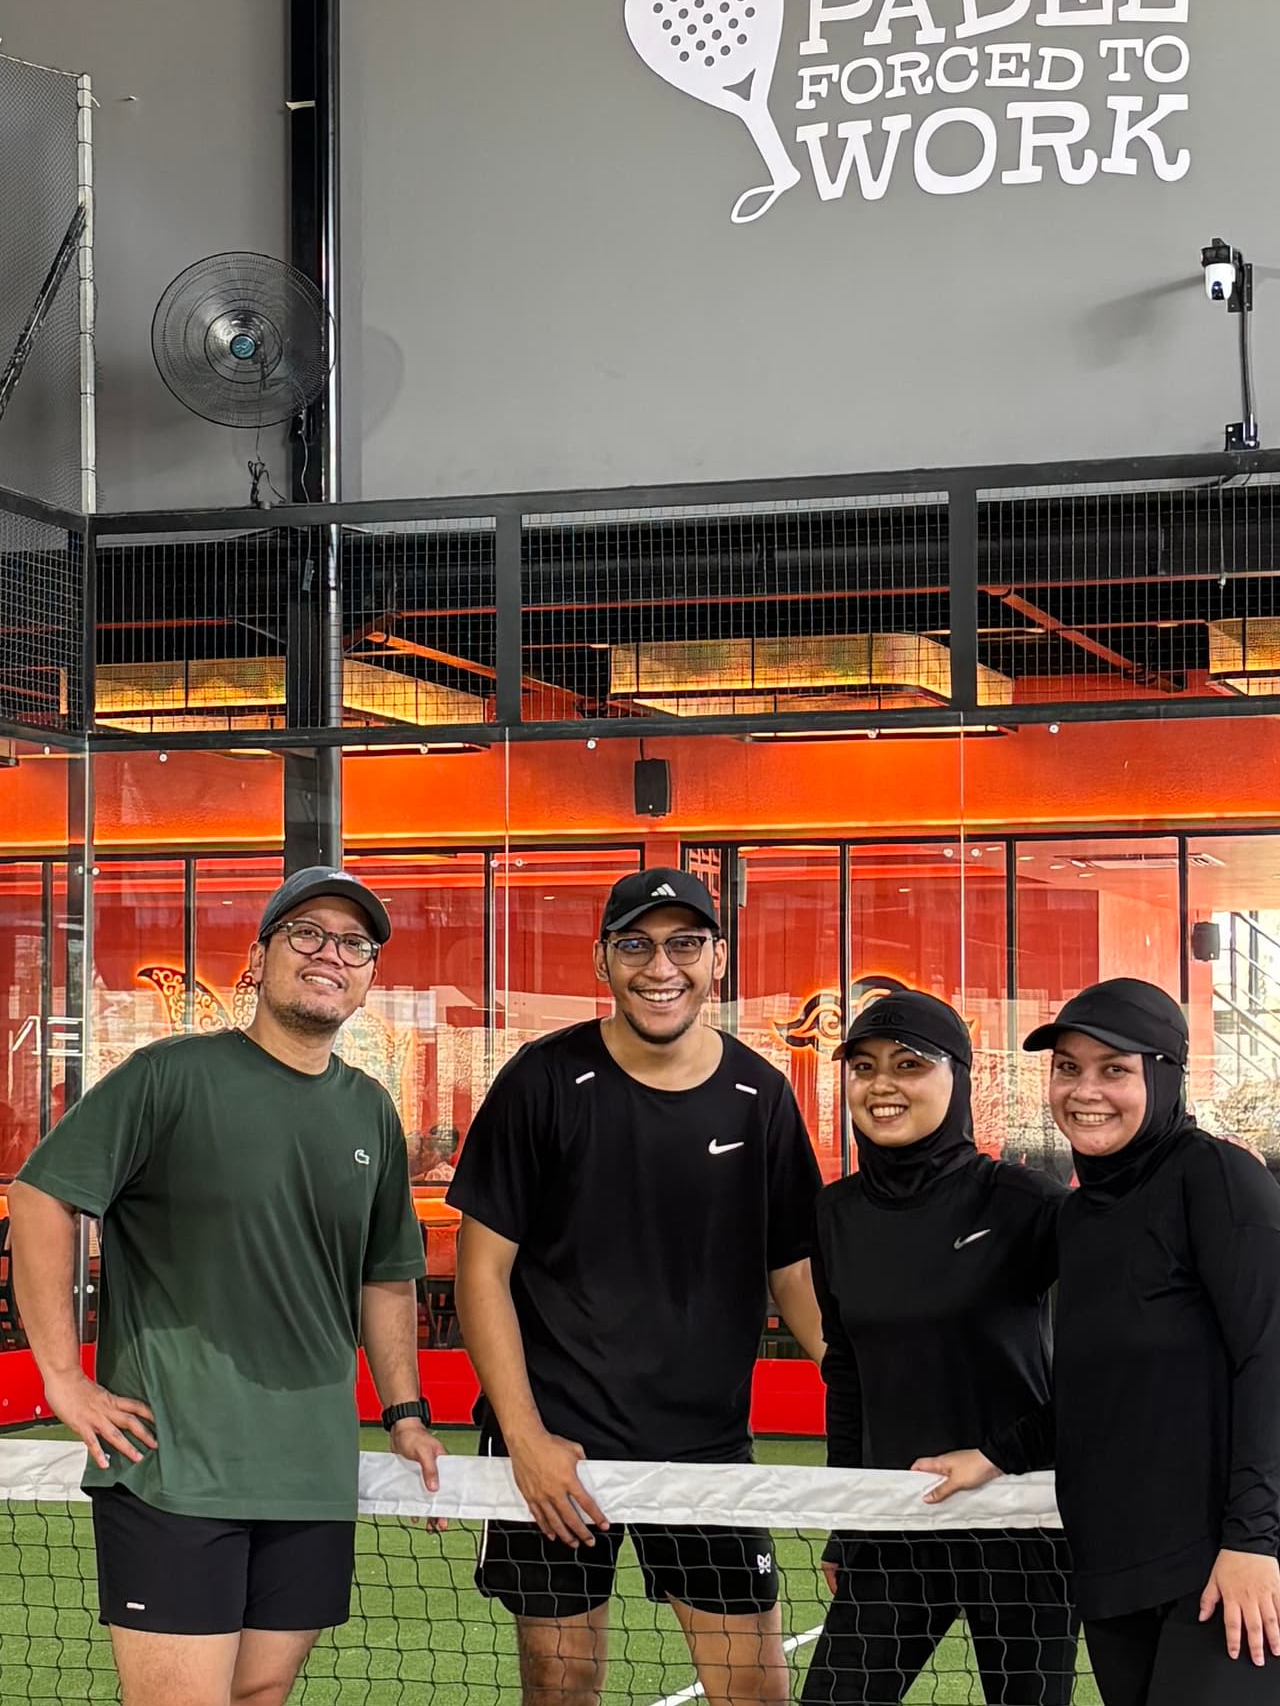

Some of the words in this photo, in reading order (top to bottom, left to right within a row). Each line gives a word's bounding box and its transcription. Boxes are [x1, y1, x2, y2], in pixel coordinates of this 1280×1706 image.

[795, 42, 1084, 110] FORCED
[1098, 34, 1190, 83] TO
[795, 93, 1191, 201] WORK
